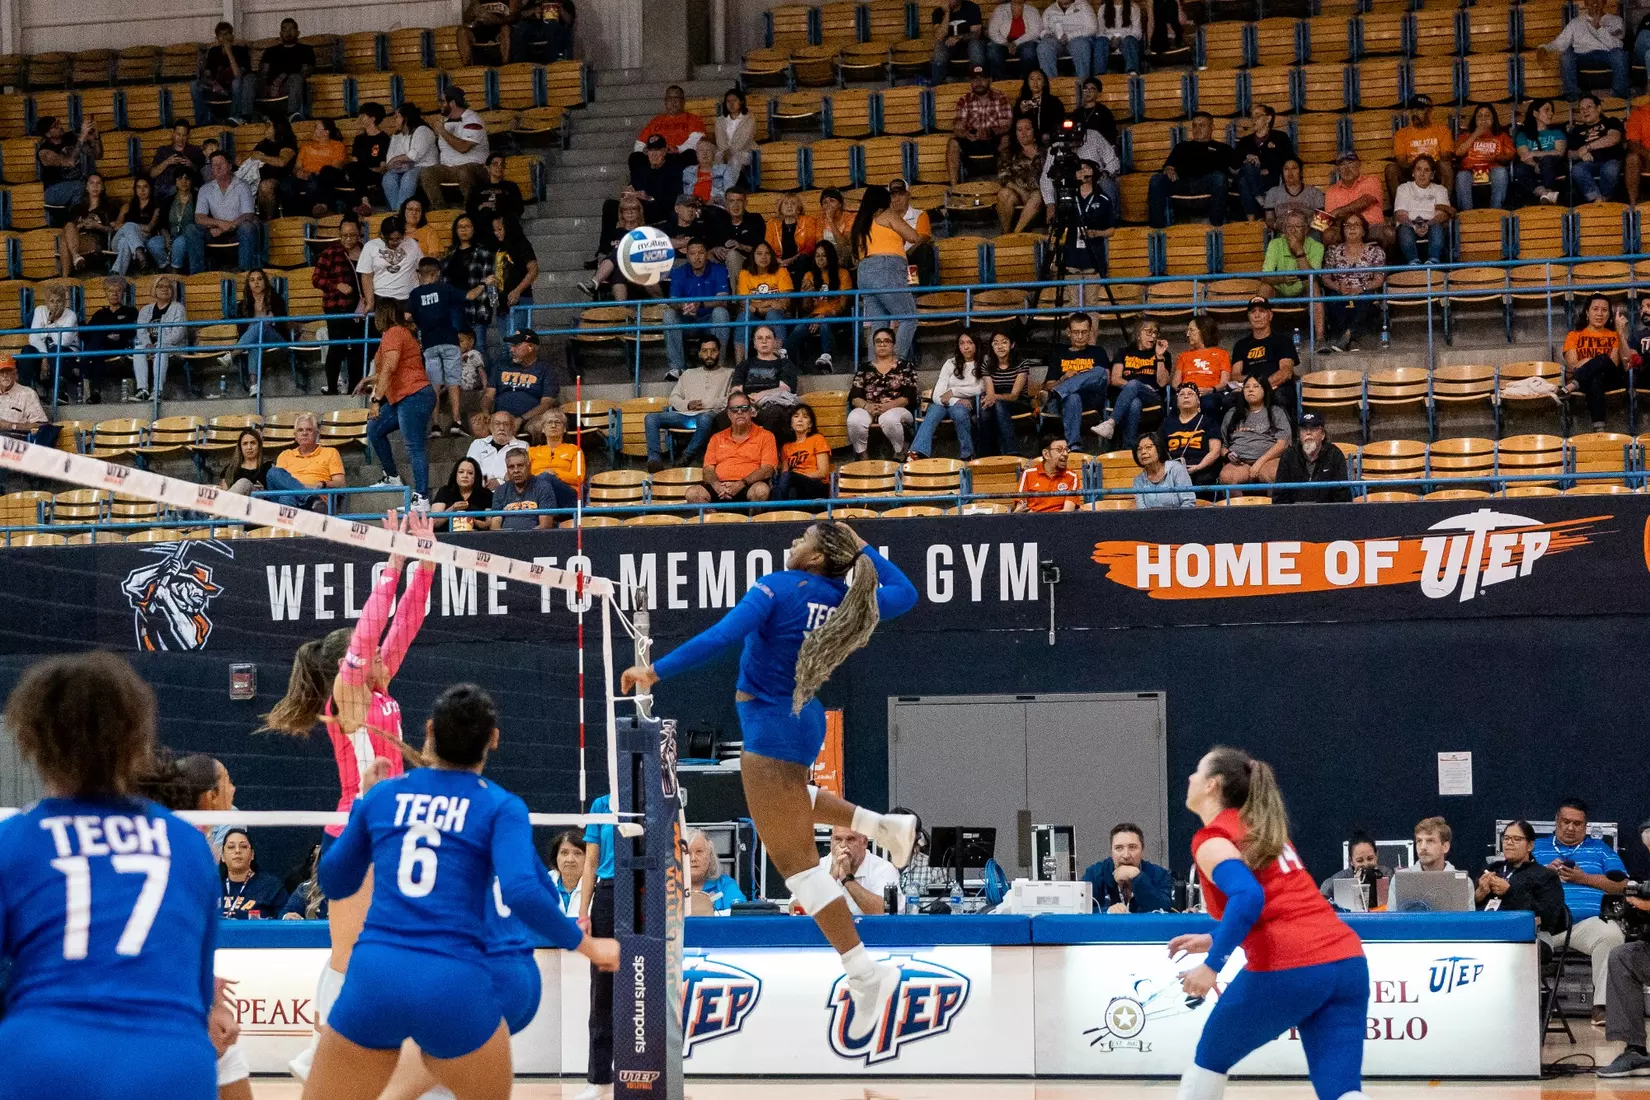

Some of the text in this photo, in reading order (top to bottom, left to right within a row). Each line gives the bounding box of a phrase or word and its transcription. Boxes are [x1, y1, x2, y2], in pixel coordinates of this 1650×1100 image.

[637, 240, 668, 250] molten
[643, 250, 667, 262] NCAA
[1577, 335, 1617, 348] UTEP
[501, 371, 537, 384] UTEP
[198, 486, 219, 501] UTEP
[279, 506, 298, 519] UTEP
[352, 523, 369, 536] UTEP
[417, 538, 433, 549] UTEP
[477, 552, 491, 563] UTEP
[1137, 508, 1552, 602] HOME OF UTEP
[530, 564, 545, 575] UTEP
[533, 555, 592, 613] TO
[927, 542, 1039, 603] GYM
[807, 602, 838, 629] TEC
[380, 700, 400, 716] UT
[394, 793, 470, 832] TECH
[40, 815, 171, 858] TECH
[397, 822, 442, 898] 6
[51, 854, 171, 960] 17
[1429, 956, 1484, 994] UTEP
[633, 955, 646, 1053] sports imports
[683, 962, 757, 1046] TEP
[1581, 993, 1587, 1003] 3
[838, 964, 963, 1054] UTEP
[619, 1069, 660, 1083] UTEP
